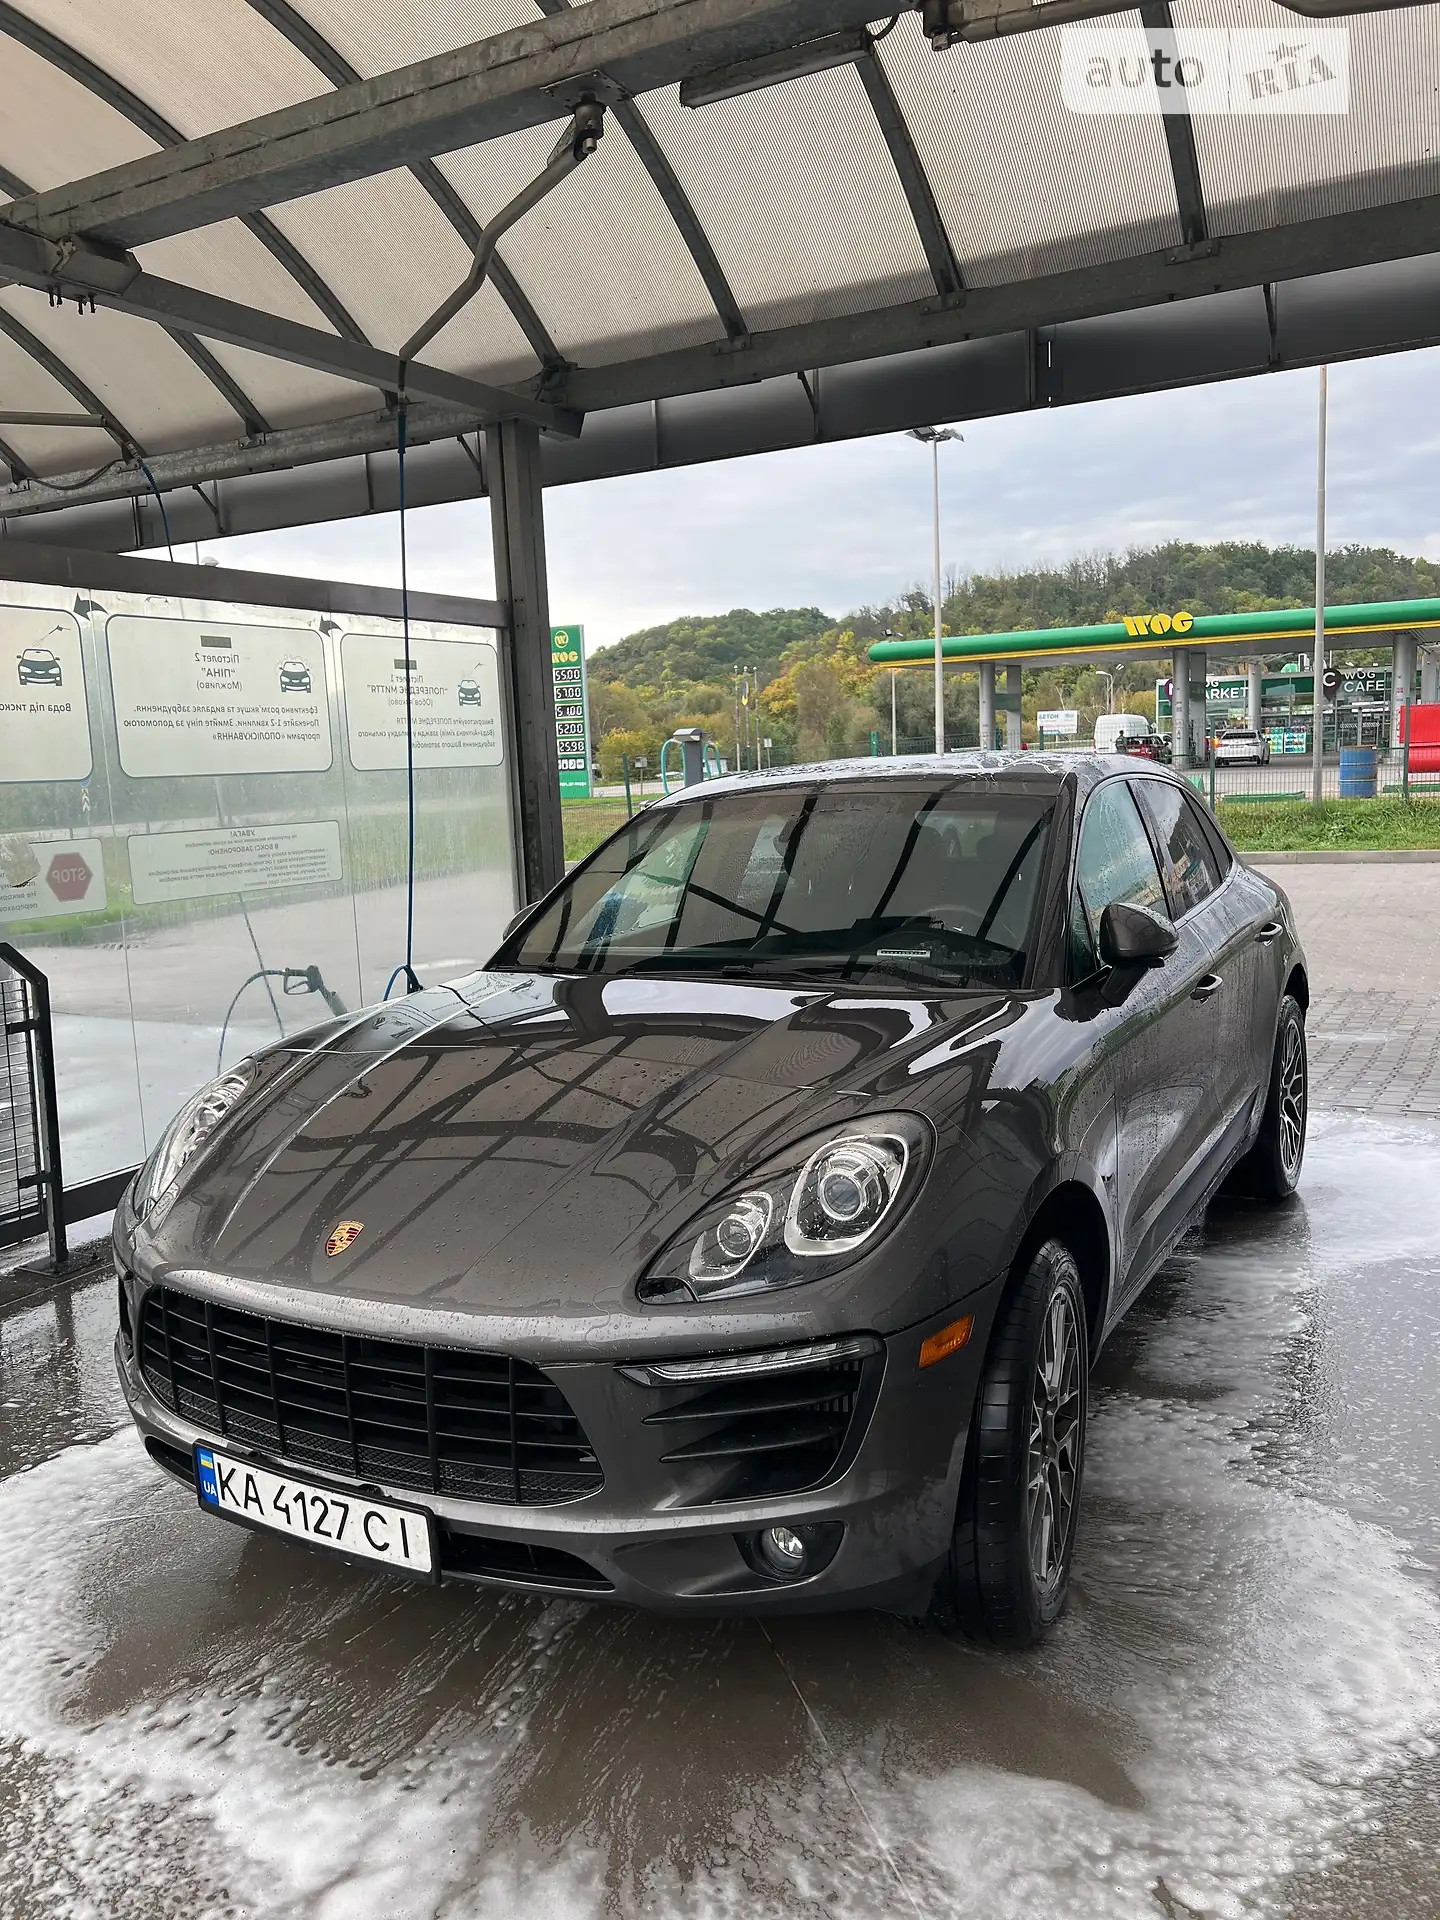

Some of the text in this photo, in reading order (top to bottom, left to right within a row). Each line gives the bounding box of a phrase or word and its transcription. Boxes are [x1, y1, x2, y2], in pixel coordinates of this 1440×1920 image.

[1122, 611, 1193, 637] WOG
[1345, 670, 1376, 679] WOG
[1344, 680, 1385, 692] CAFE
[203, 1480, 217, 1497] UA
[217, 1462, 410, 1559] KA 4127 CI
